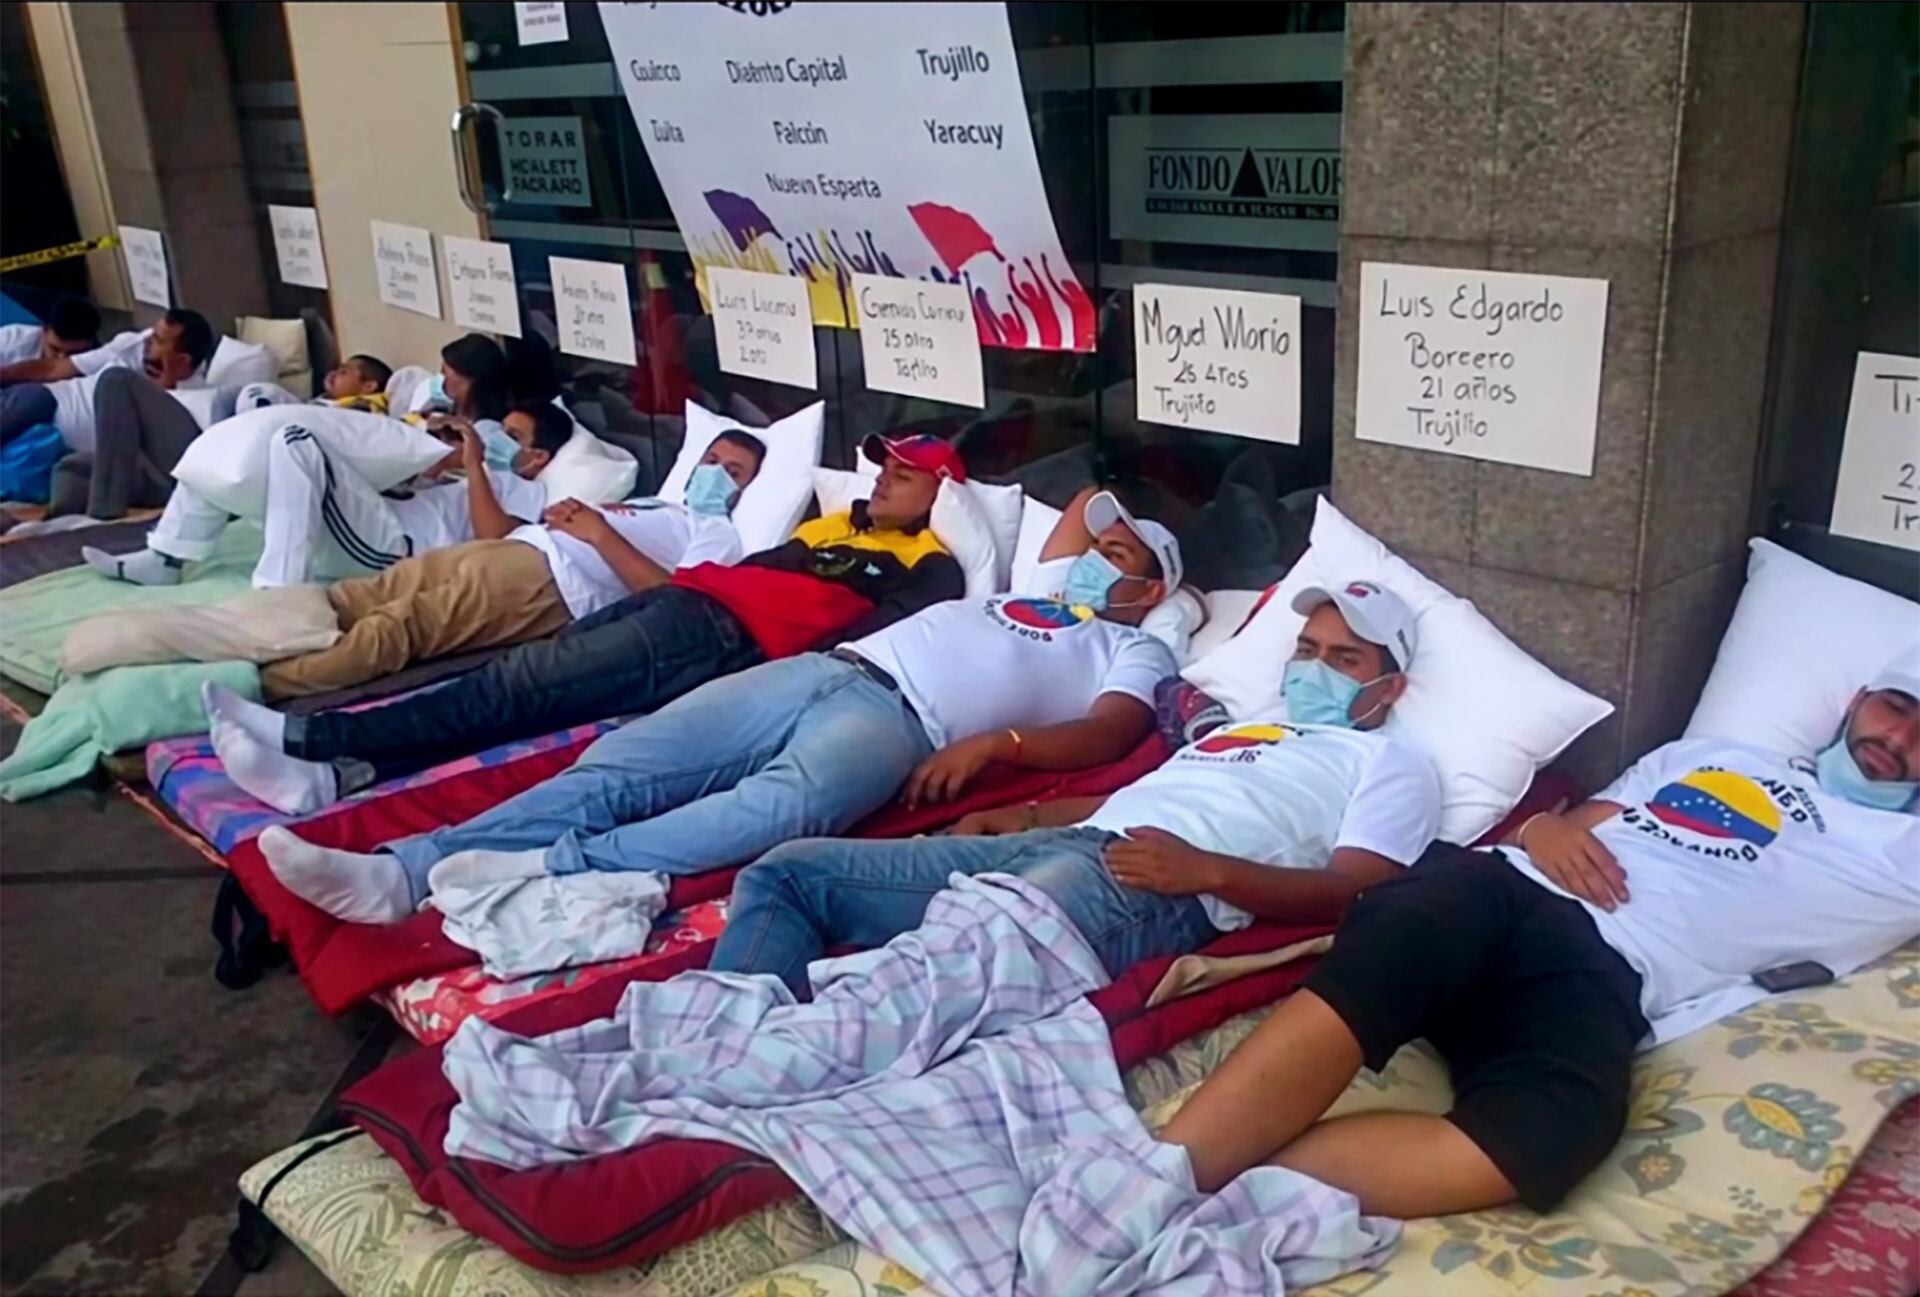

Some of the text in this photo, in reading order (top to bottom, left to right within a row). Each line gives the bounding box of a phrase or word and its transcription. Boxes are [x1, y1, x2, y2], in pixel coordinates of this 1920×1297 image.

[785, 55, 848, 87] Capital
[916, 45, 990, 81] Trujillo
[923, 119, 1004, 150] Yaracuy
[817, 173, 882, 200] Esparta
[1149, 155, 1231, 192] FONDO
[1380, 278, 1564, 336] Luis Edgardo
[1420, 375, 1517, 404] 21 años
[1406, 406, 1488, 446] Trujillo
